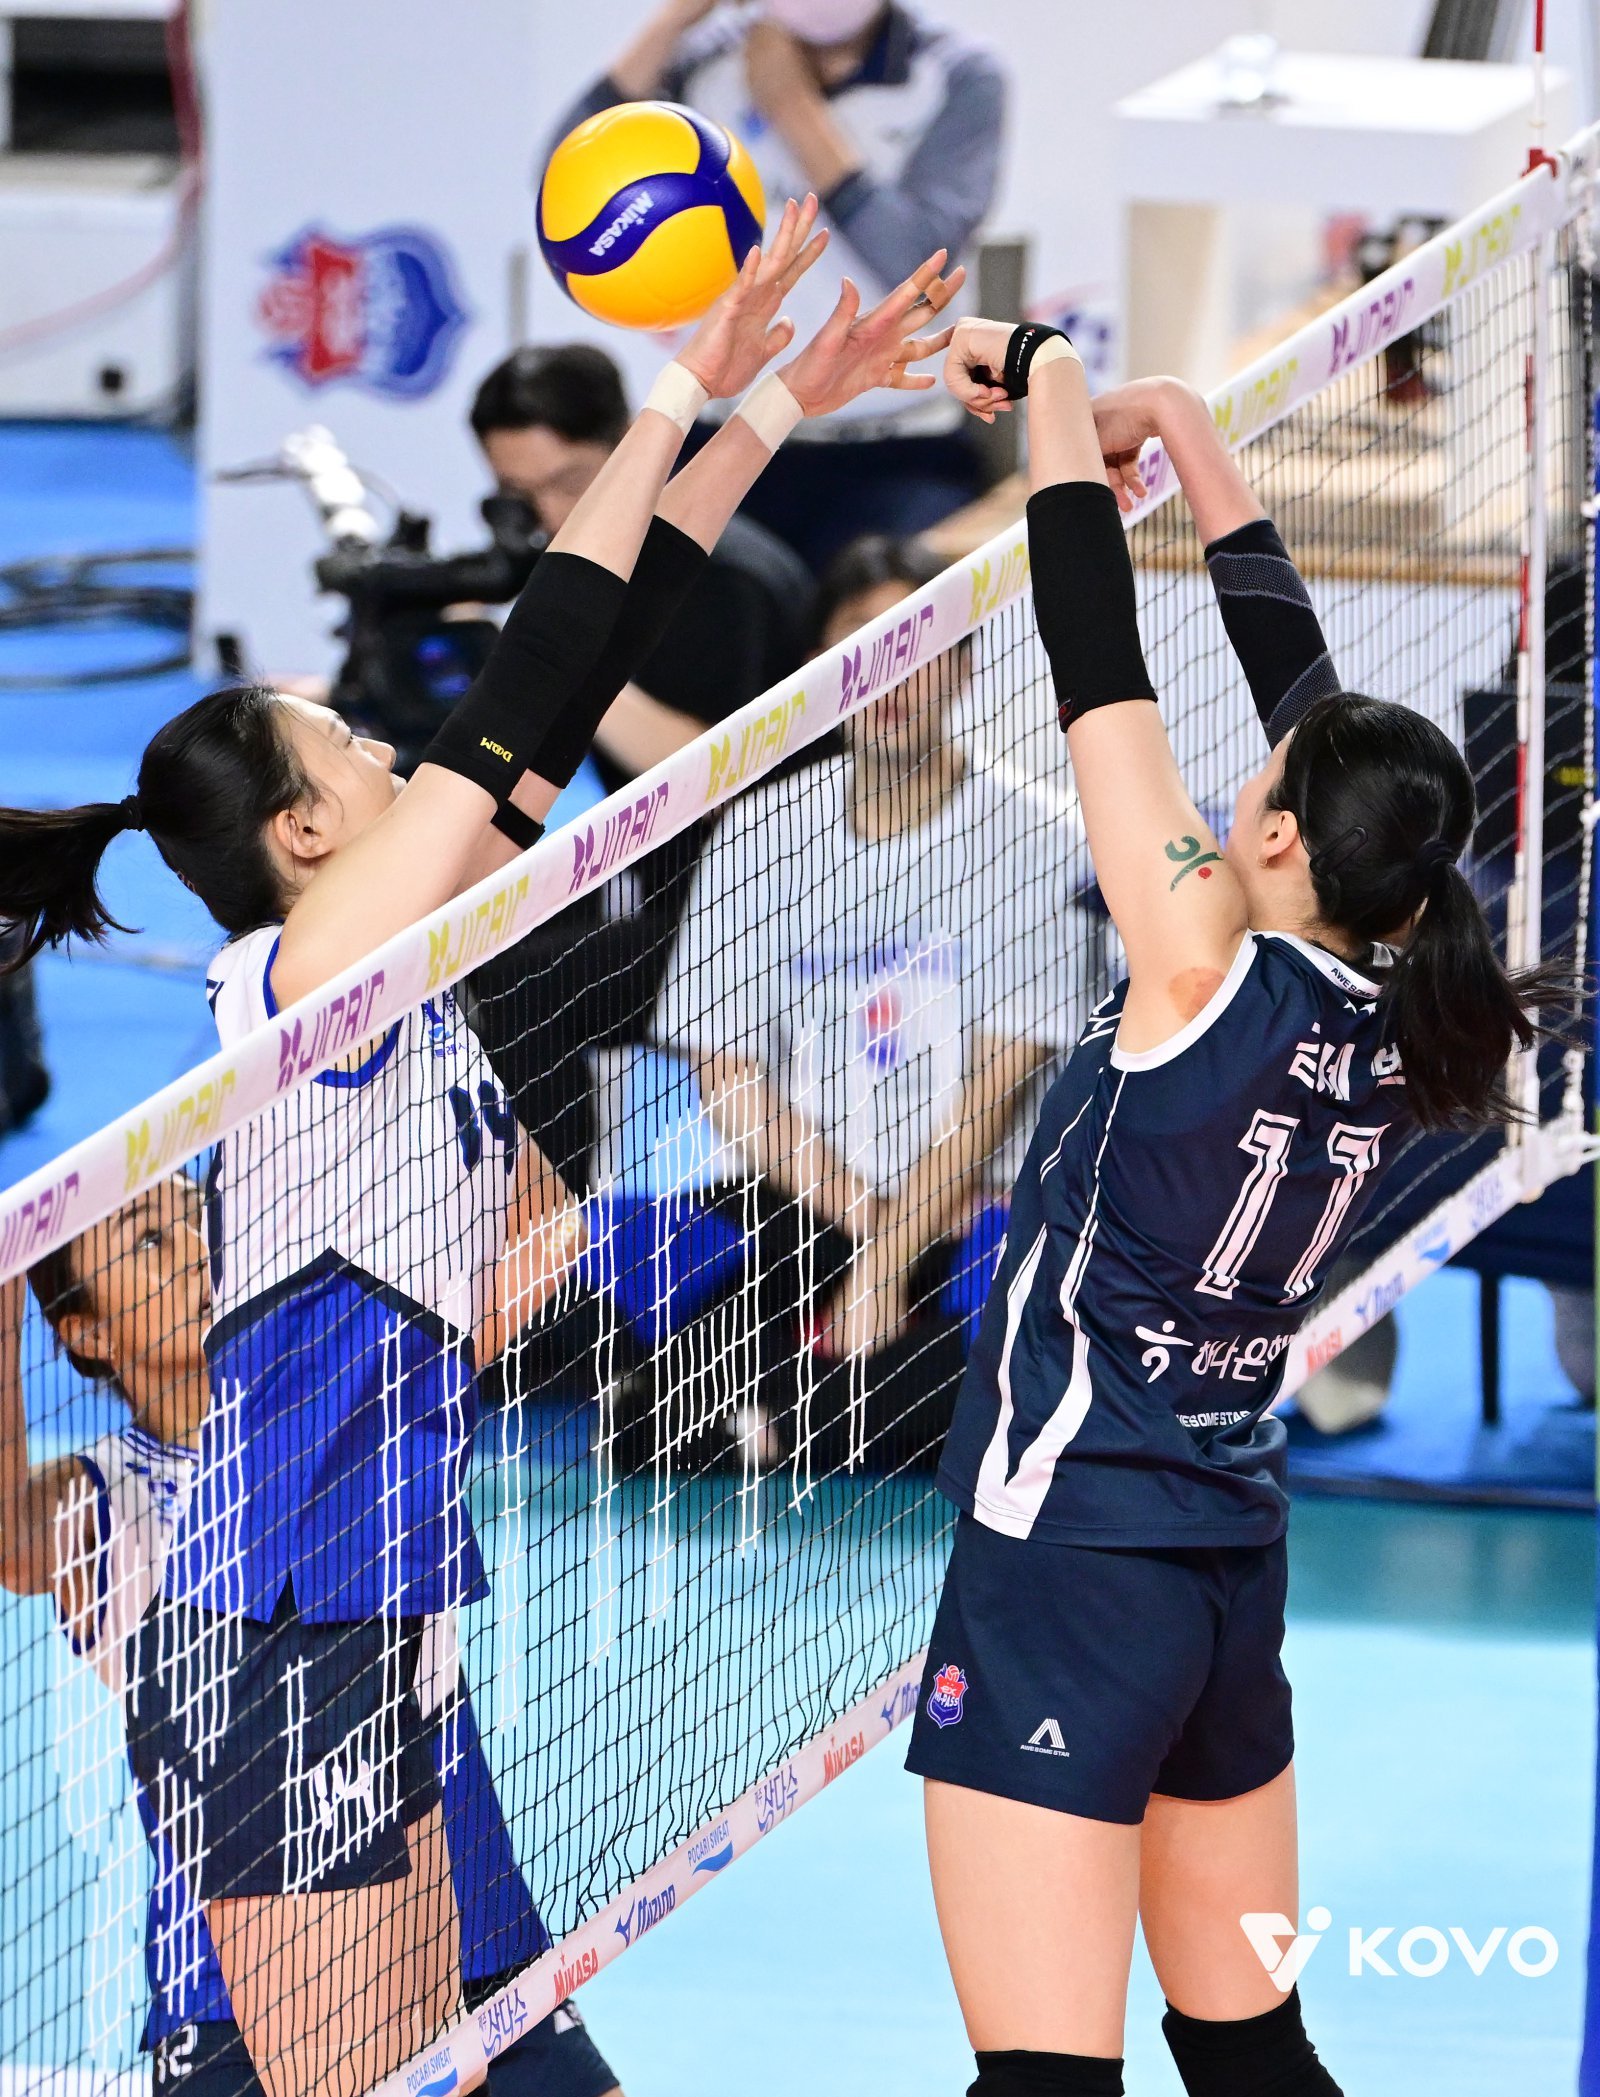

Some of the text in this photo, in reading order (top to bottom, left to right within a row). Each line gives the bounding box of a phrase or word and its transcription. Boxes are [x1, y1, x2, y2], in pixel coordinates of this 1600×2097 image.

[588, 191, 654, 256] MIKASA
[1195, 1109, 1391, 1305] 11
[823, 1730, 865, 1789] MIKASA
[687, 1819, 731, 1868] POCARI SWEAT
[553, 1947, 599, 2006] MIKASA
[406, 2046, 453, 2094] POCARI SWEAT
